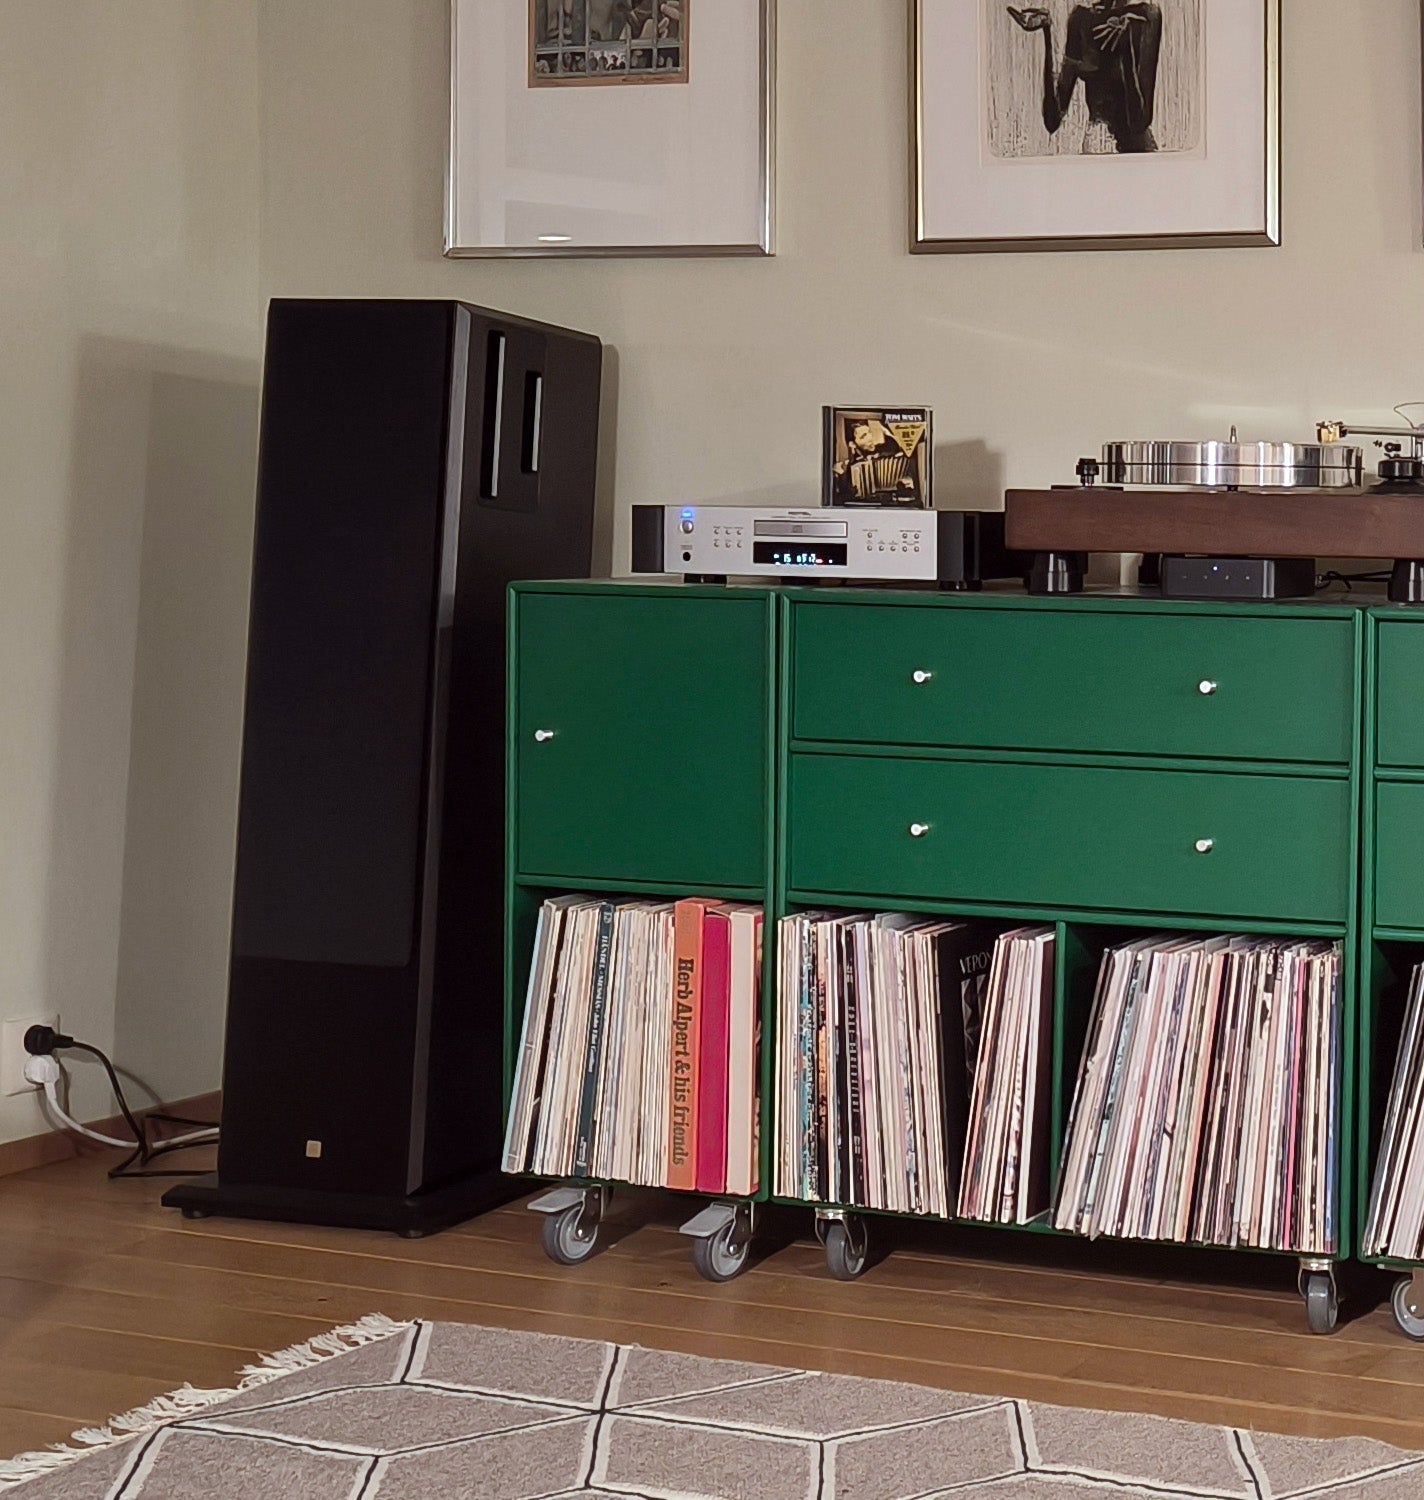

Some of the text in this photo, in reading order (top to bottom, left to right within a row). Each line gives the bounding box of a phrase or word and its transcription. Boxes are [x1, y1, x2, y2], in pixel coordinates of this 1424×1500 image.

[672, 957, 694, 1166] Herb Alpert & his friends
